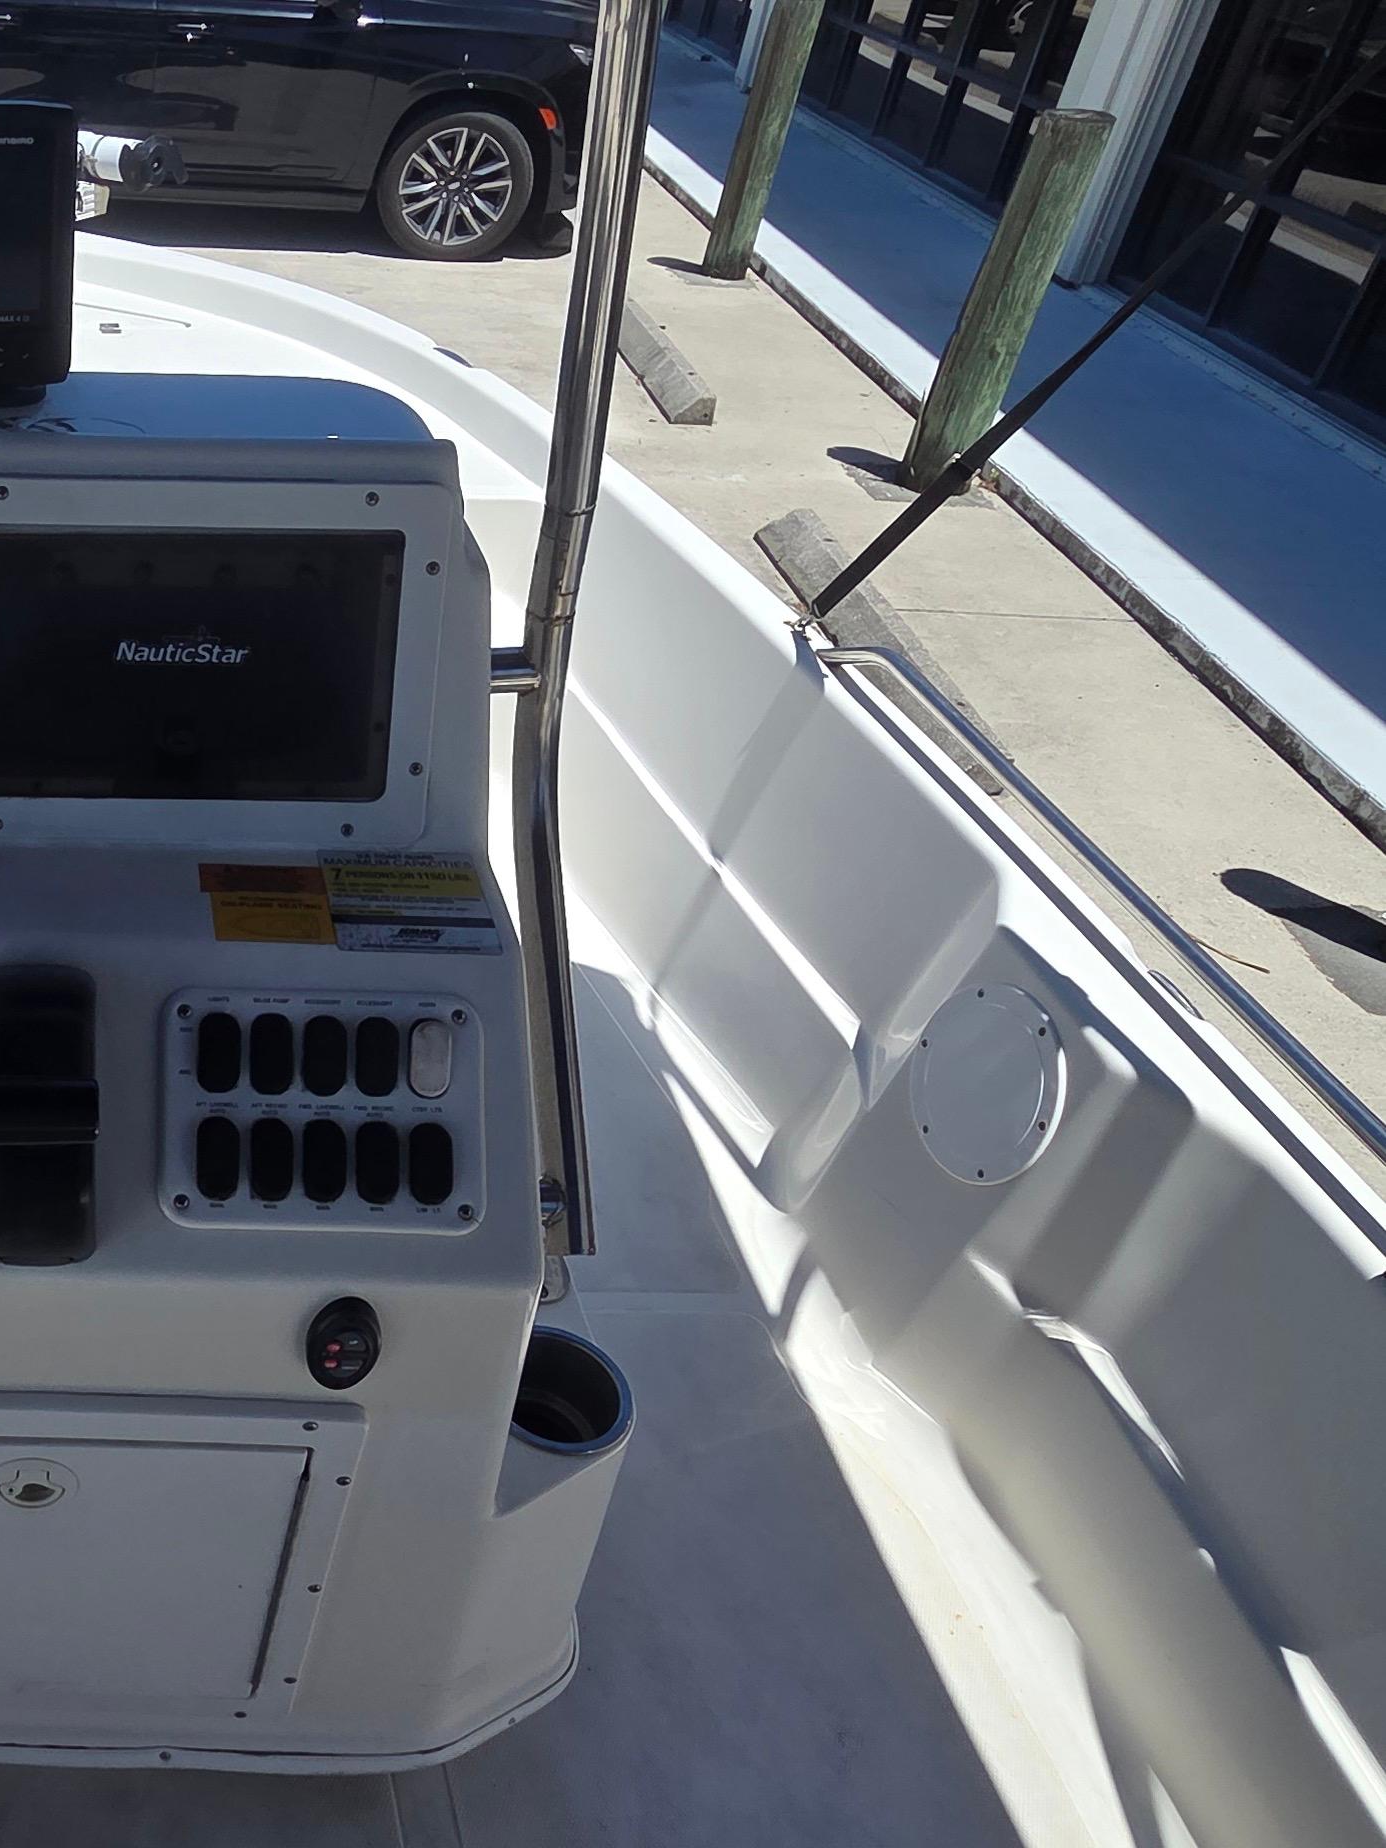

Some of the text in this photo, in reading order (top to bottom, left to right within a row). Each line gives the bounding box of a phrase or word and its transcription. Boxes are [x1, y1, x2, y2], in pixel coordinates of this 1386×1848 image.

[116, 641, 248, 664] NauticStar
[323, 857, 391, 867] MAXIMUM
[330, 867, 342, 881] 7
